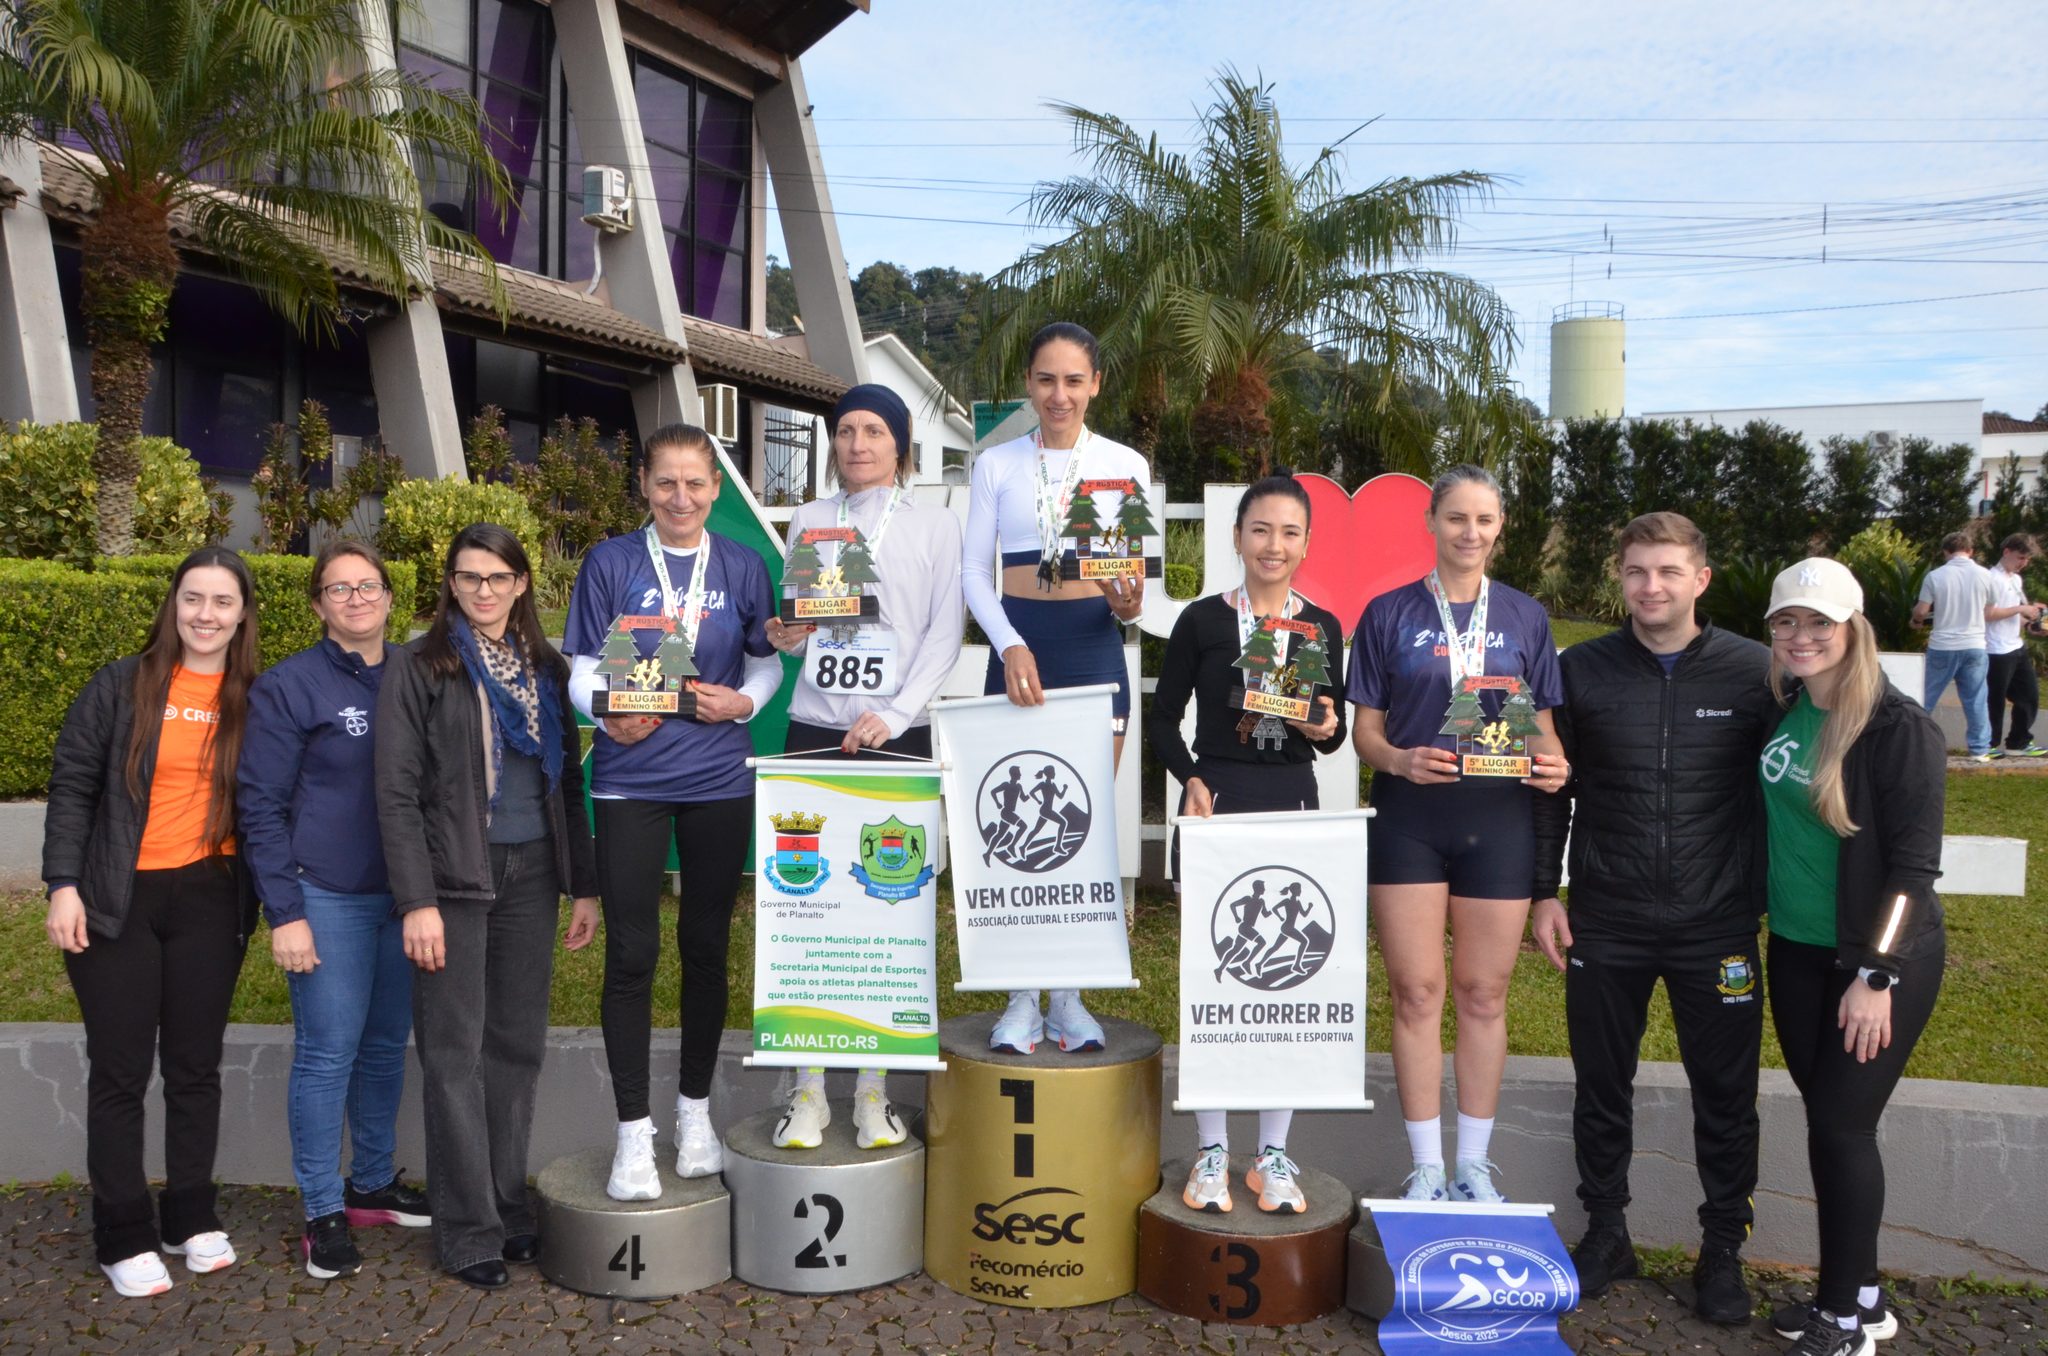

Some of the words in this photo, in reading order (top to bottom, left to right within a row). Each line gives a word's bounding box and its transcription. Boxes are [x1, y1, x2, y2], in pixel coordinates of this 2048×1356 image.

[1098, 561, 1132, 570] LUGAR
[813, 600, 847, 609] LUGAR
[798, 608, 834, 616] FEMININO
[816, 655, 884, 690] 885
[628, 694, 664, 703] LUGAR
[1263, 696, 1297, 710] LUGAR
[1247, 702, 1282, 714] FEMININO
[1283, 710, 1300, 719] 5KM
[1706, 709, 1733, 717] Sicredi
[1482, 759, 1517, 768] LUGAR
[1466, 767, 1503, 775] FEMININO
[778, 886, 815, 895] PLANALTO
[965, 887, 1006, 910] VEM
[1010, 883, 1085, 908] CORRER
[1090, 881, 1116, 904] RB
[760, 901, 797, 909] Governo
[799, 901, 841, 911] Municipal
[789, 911, 824, 919] Planalto
[968, 914, 1019, 929] ASSOCIAÇÃO
[1020, 913, 1062, 926] CULTURAL
[1063, 912, 1069, 923] E
[1071, 911, 1118, 924] ESPORTIVA
[771, 934, 779, 942] O
[781, 935, 822, 944] Governo
[824, 935, 871, 946] Municipal
[873, 937, 885, 945] de
[888, 937, 927, 947] Planalto
[804, 949, 860, 960] juntamente
[863, 952, 884, 960] com
[770, 963, 819, 972] Secretaria
[821, 963, 868, 974] Municipal
[870, 965, 883, 974] de
[885, 965, 927, 976] Esportes
[779, 978, 807, 988] apoia
[822, 978, 855, 987] atletas
[857, 979, 918, 989] planaltenses
[768, 992, 786, 1001] que
[788, 991, 815, 1000] estão
[817, 993, 864, 1002] presentes
[867, 994, 893, 1002] neste
[895, 995, 929, 1004] evento
[893, 1014, 929, 1022] PLANALTO
[1191, 1004, 1234, 1025] VEM
[1240, 1003, 1320, 1024] CORRER
[1326, 1003, 1354, 1024] RB
[760, 1033, 878, 1050] PLANALTO-RS
[1190, 1031, 1247, 1045] ASSOCIAÇÃO
[1249, 1032, 1294, 1043] CULTURAL
[1296, 1033, 1302, 1043] E
[1304, 1032, 1354, 1043] ESPORTIVA
[1000, 1078, 1034, 1178] 1
[793, 1193, 847, 1269] 2
[608, 1234, 646, 1281] 4
[1208, 1243, 1262, 1320] 3
[1493, 1288, 1546, 1308] GCOR
[1440, 1325, 1473, 1342] Desde
[1474, 1328, 1499, 1342] 2025
